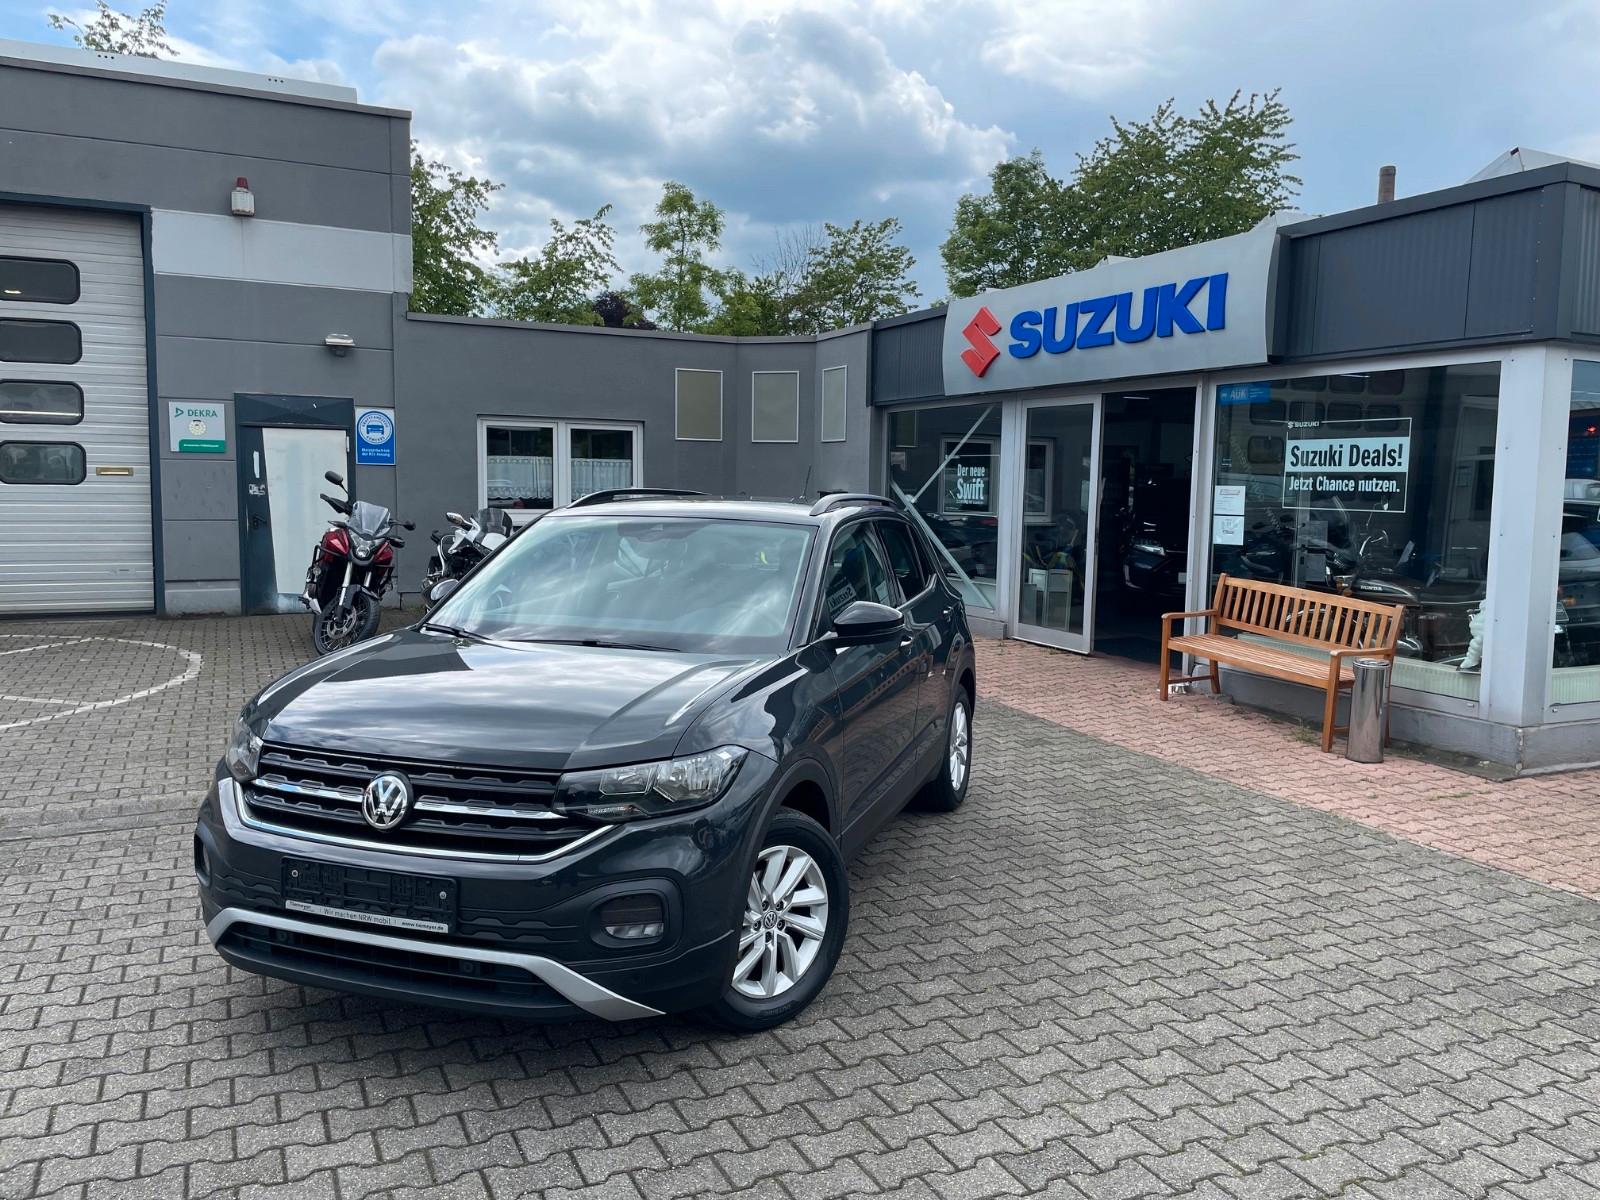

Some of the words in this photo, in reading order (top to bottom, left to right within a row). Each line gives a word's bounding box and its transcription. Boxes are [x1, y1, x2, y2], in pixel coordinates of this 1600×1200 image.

[1008, 272, 1229, 359] SUZUKI
[187, 408, 218, 418] DEKRA
[1290, 443, 1344, 468] Suzuki
[1348, 443, 1403, 467] Deals!
[957, 463, 969, 477] Der
[969, 466, 986, 477] neue
[956, 478, 985, 500] Swift
[1288, 475, 1314, 491] Jetzt
[1315, 475, 1355, 492] Chance
[1357, 477, 1401, 493] nutzen.
